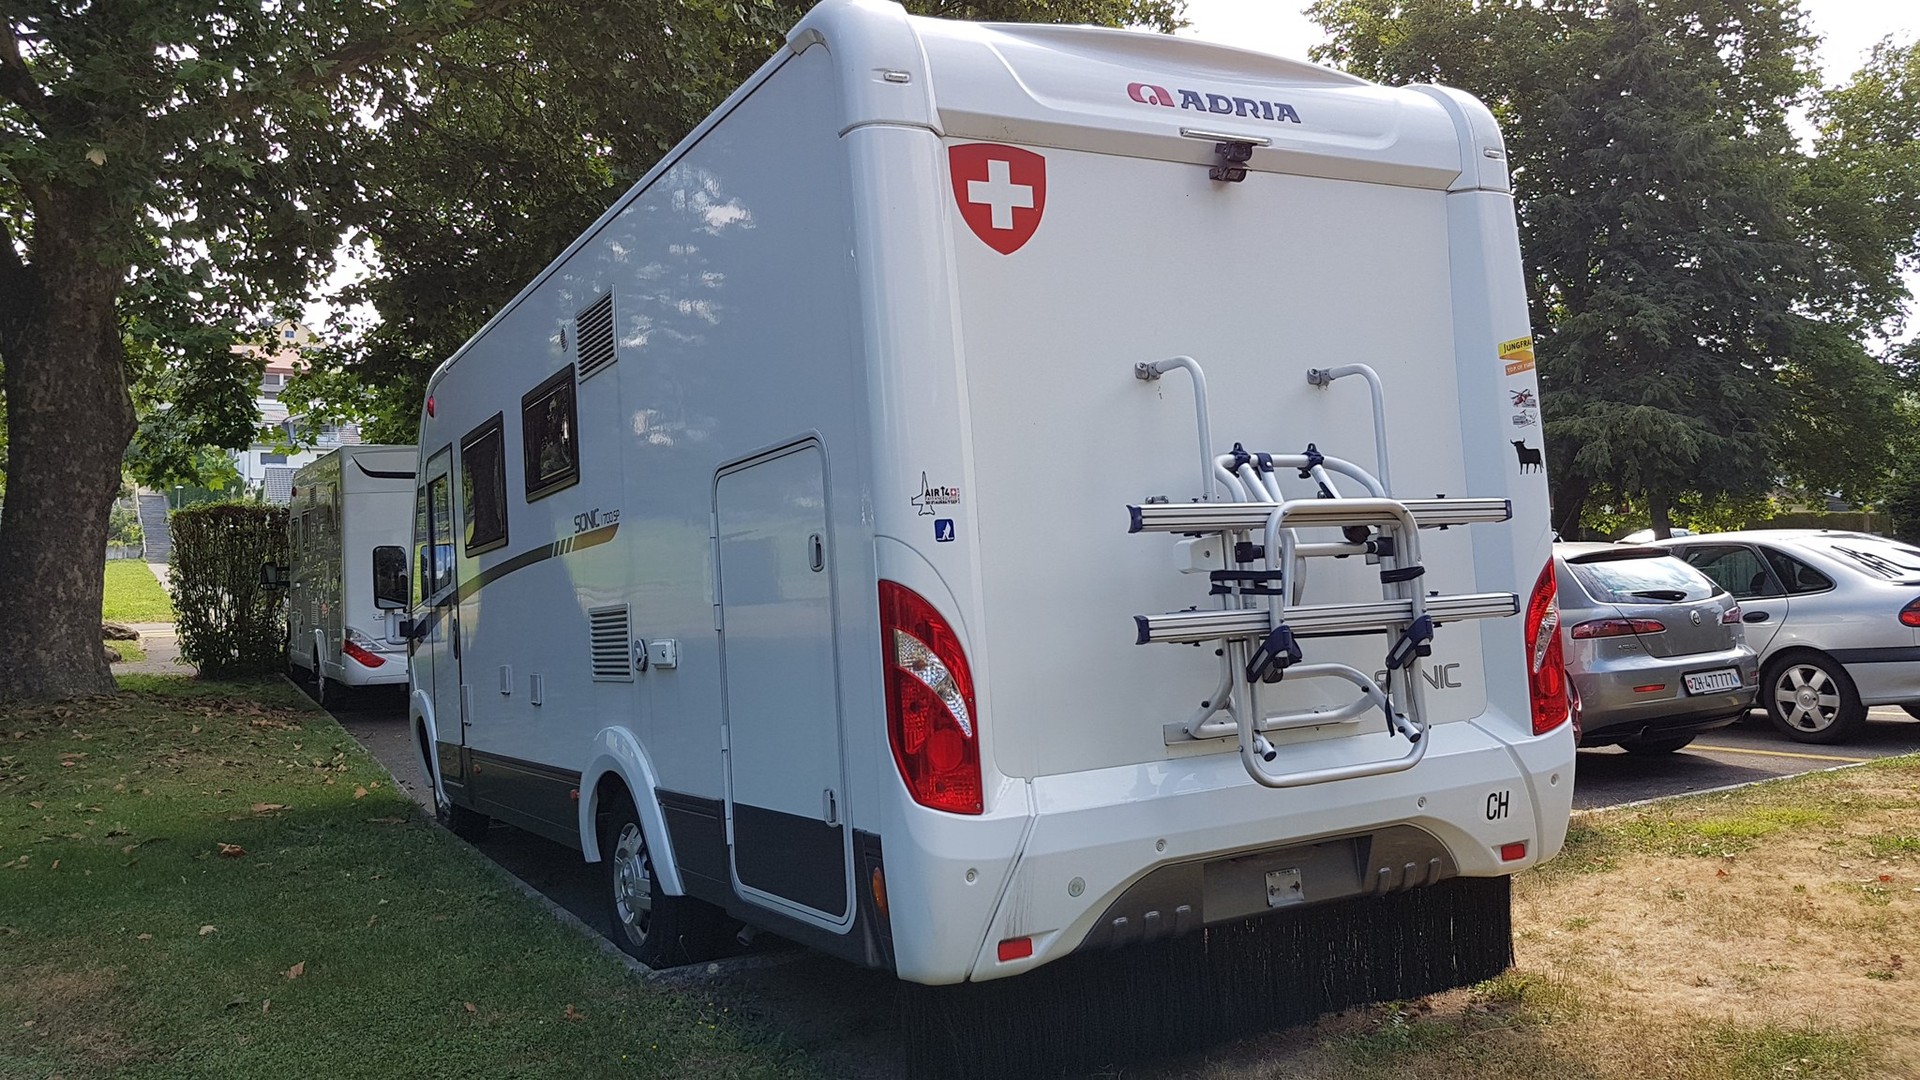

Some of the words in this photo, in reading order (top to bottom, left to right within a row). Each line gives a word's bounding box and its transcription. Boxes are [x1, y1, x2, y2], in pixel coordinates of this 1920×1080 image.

[1178, 89, 1301, 124] ADRIA
[1503, 338, 1533, 354] JUNGFRA
[574, 508, 600, 534] SONIC
[1486, 790, 1510, 821] CH
